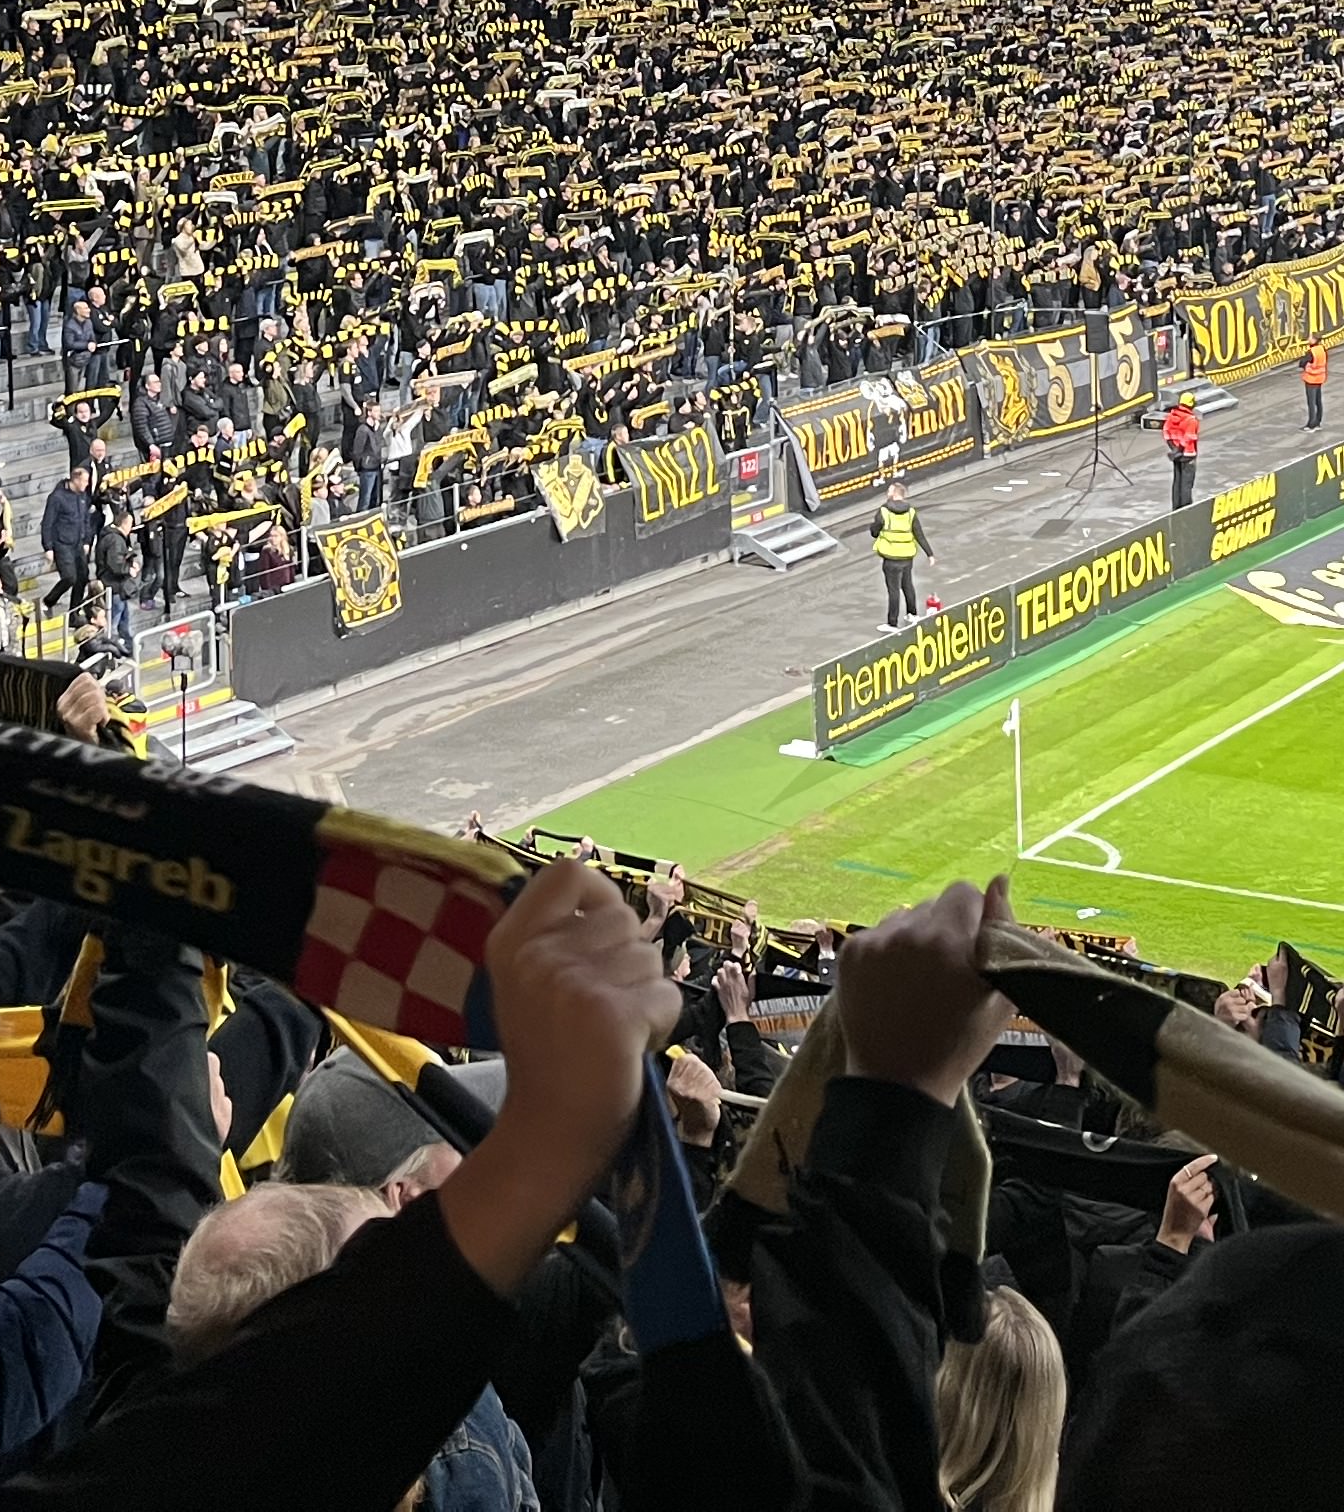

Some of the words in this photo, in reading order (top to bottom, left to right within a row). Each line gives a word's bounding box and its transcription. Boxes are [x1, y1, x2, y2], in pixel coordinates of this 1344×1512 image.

[1190, 297, 1260, 367] SOL
[1016, 531, 1171, 641] TELEOPTION.
[823, 596, 1005, 721] themobilelife
[1, 803, 240, 913] Zagreb
